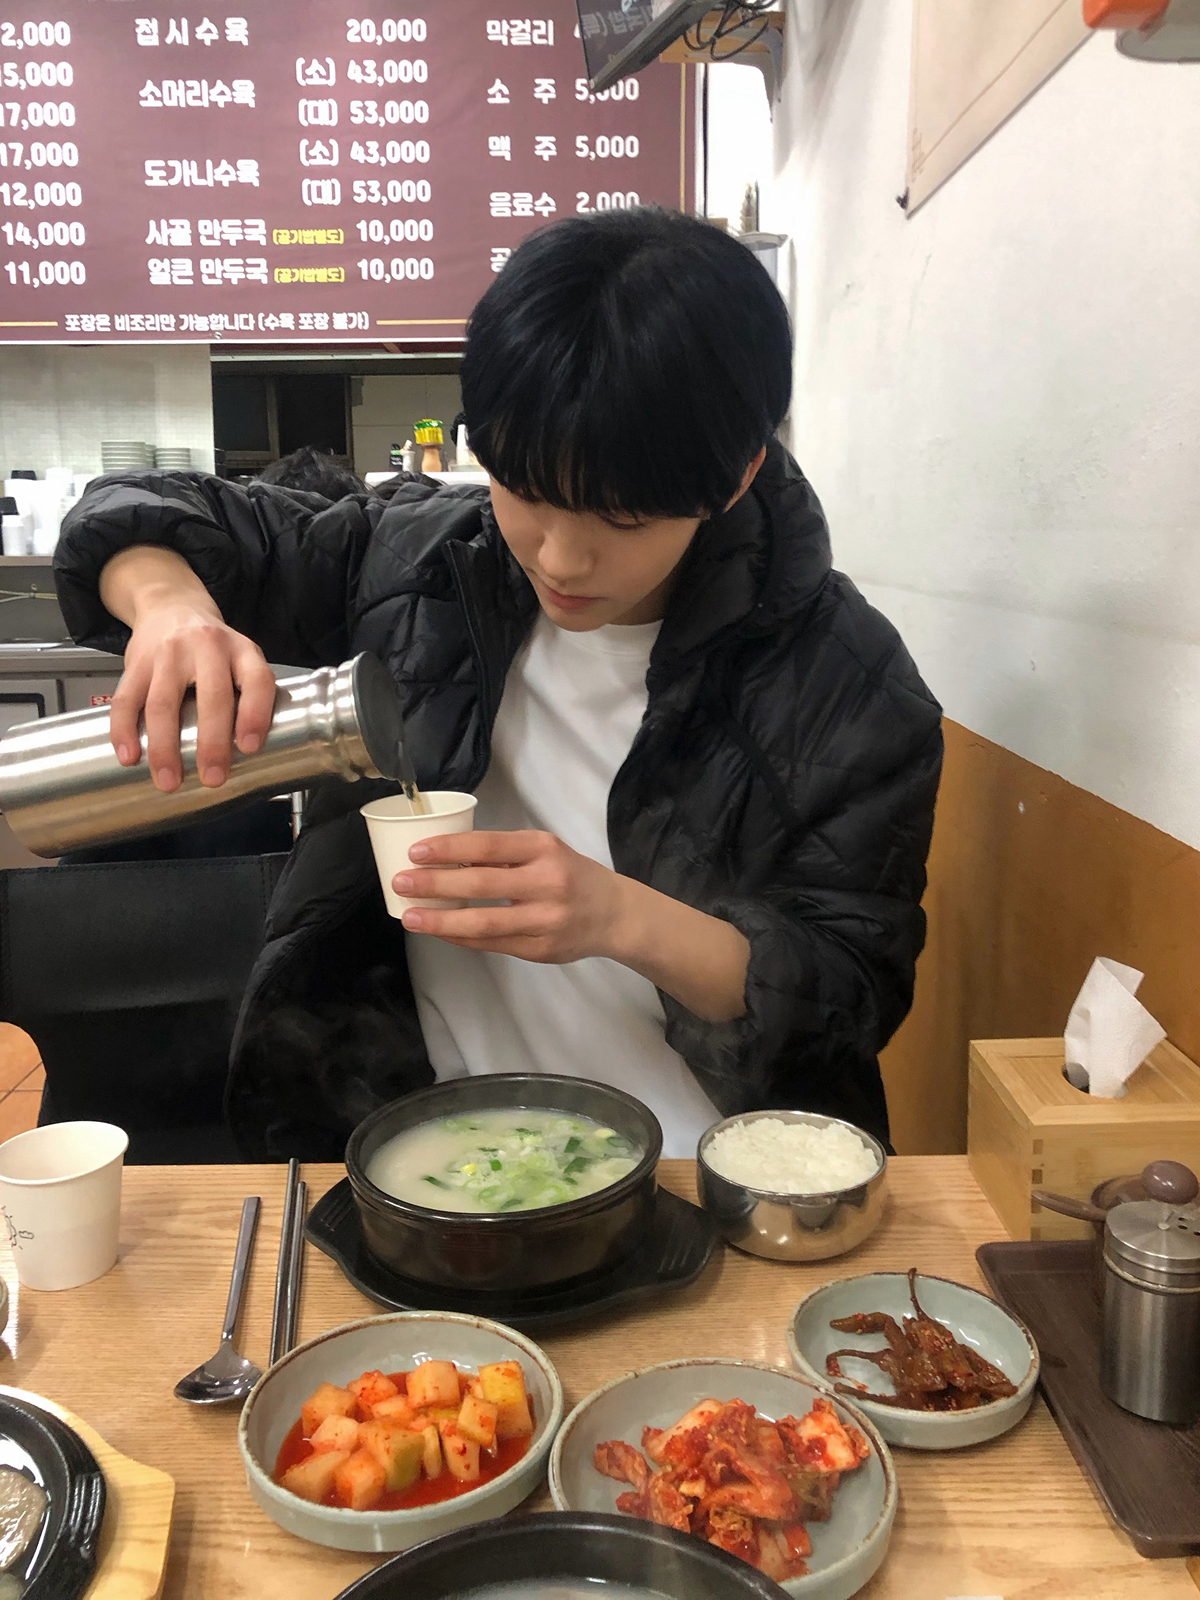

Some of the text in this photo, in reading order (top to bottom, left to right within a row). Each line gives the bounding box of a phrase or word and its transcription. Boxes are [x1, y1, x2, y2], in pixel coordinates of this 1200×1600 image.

[346, 18, 427, 46] 20,000
[486, 18, 554, 46] 막걸리
[0, 61, 74, 91] 5,000
[295, 57, 428, 87] (소) 43,000
[138, 79, 256, 108] 소머리수육
[298, 98, 430, 128] (대) 53,000
[299, 138, 431, 167] (소) 43,000
[575, 135, 639, 161] 5,000
[144, 158, 260, 187] 도가니수육
[0, 181, 83, 210] 12,000
[301, 178, 432, 207] (대) 53,000
[489, 191, 557, 218] 음료수
[1, 221, 86, 250] 14,000
[144, 218, 193, 247] 사골
[197, 218, 267, 247] 만두국
[355, 218, 434, 245] 10,000
[4, 260, 86, 289] 11,000
[147, 257, 195, 285] 얼큰
[199, 257, 269, 285] 만두국
[356, 257, 434, 284] 10,000
[65, 311, 370, 332] 포장은 비조리만 가능합니다 (수육 포장 불가)
